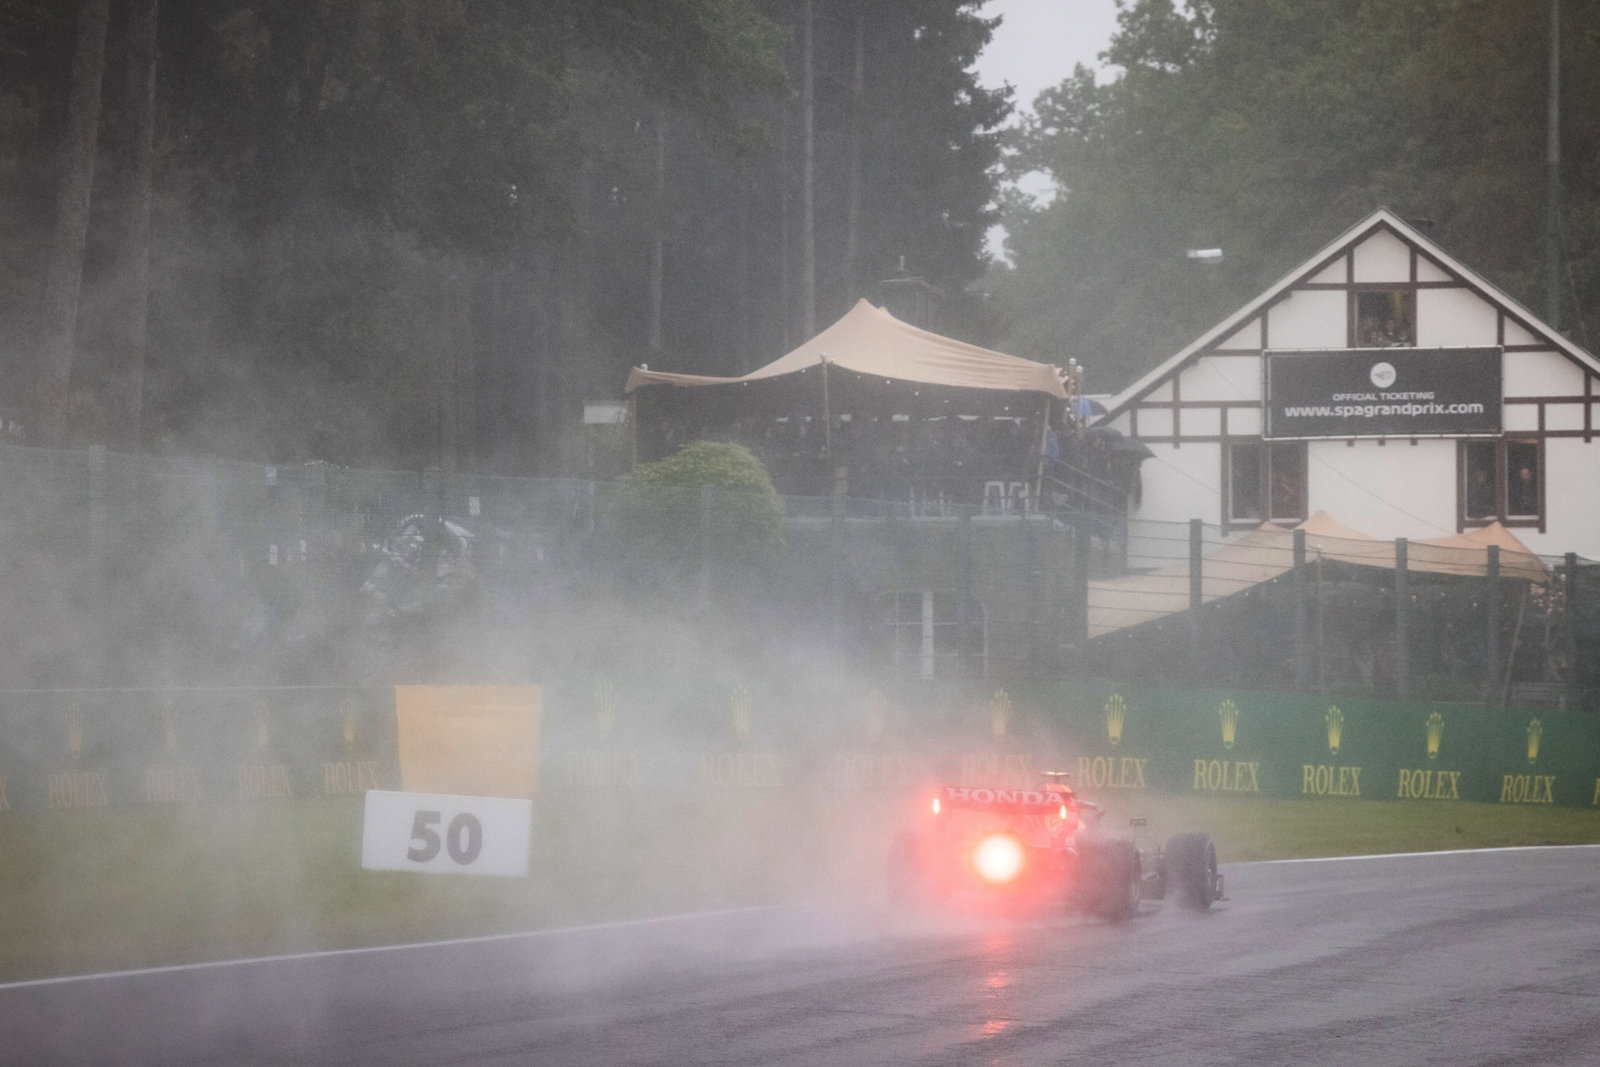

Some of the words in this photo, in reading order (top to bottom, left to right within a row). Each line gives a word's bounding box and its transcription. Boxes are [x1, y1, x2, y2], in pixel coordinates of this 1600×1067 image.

[1285, 402, 1484, 417] www.spagrandprix.com
[1333, 392, 1376, 401] OFFICIAL
[1380, 391, 1435, 400] TICKETING
[1078, 757, 1147, 788] ROLEX
[1193, 760, 1260, 792] ROLEX
[1302, 764, 1361, 796] ROLEX
[1397, 769, 1461, 800] ROLEX
[946, 788, 1065, 805] HONDA
[1500, 774, 1555, 803] ROLEX
[407, 810, 483, 865] 50
